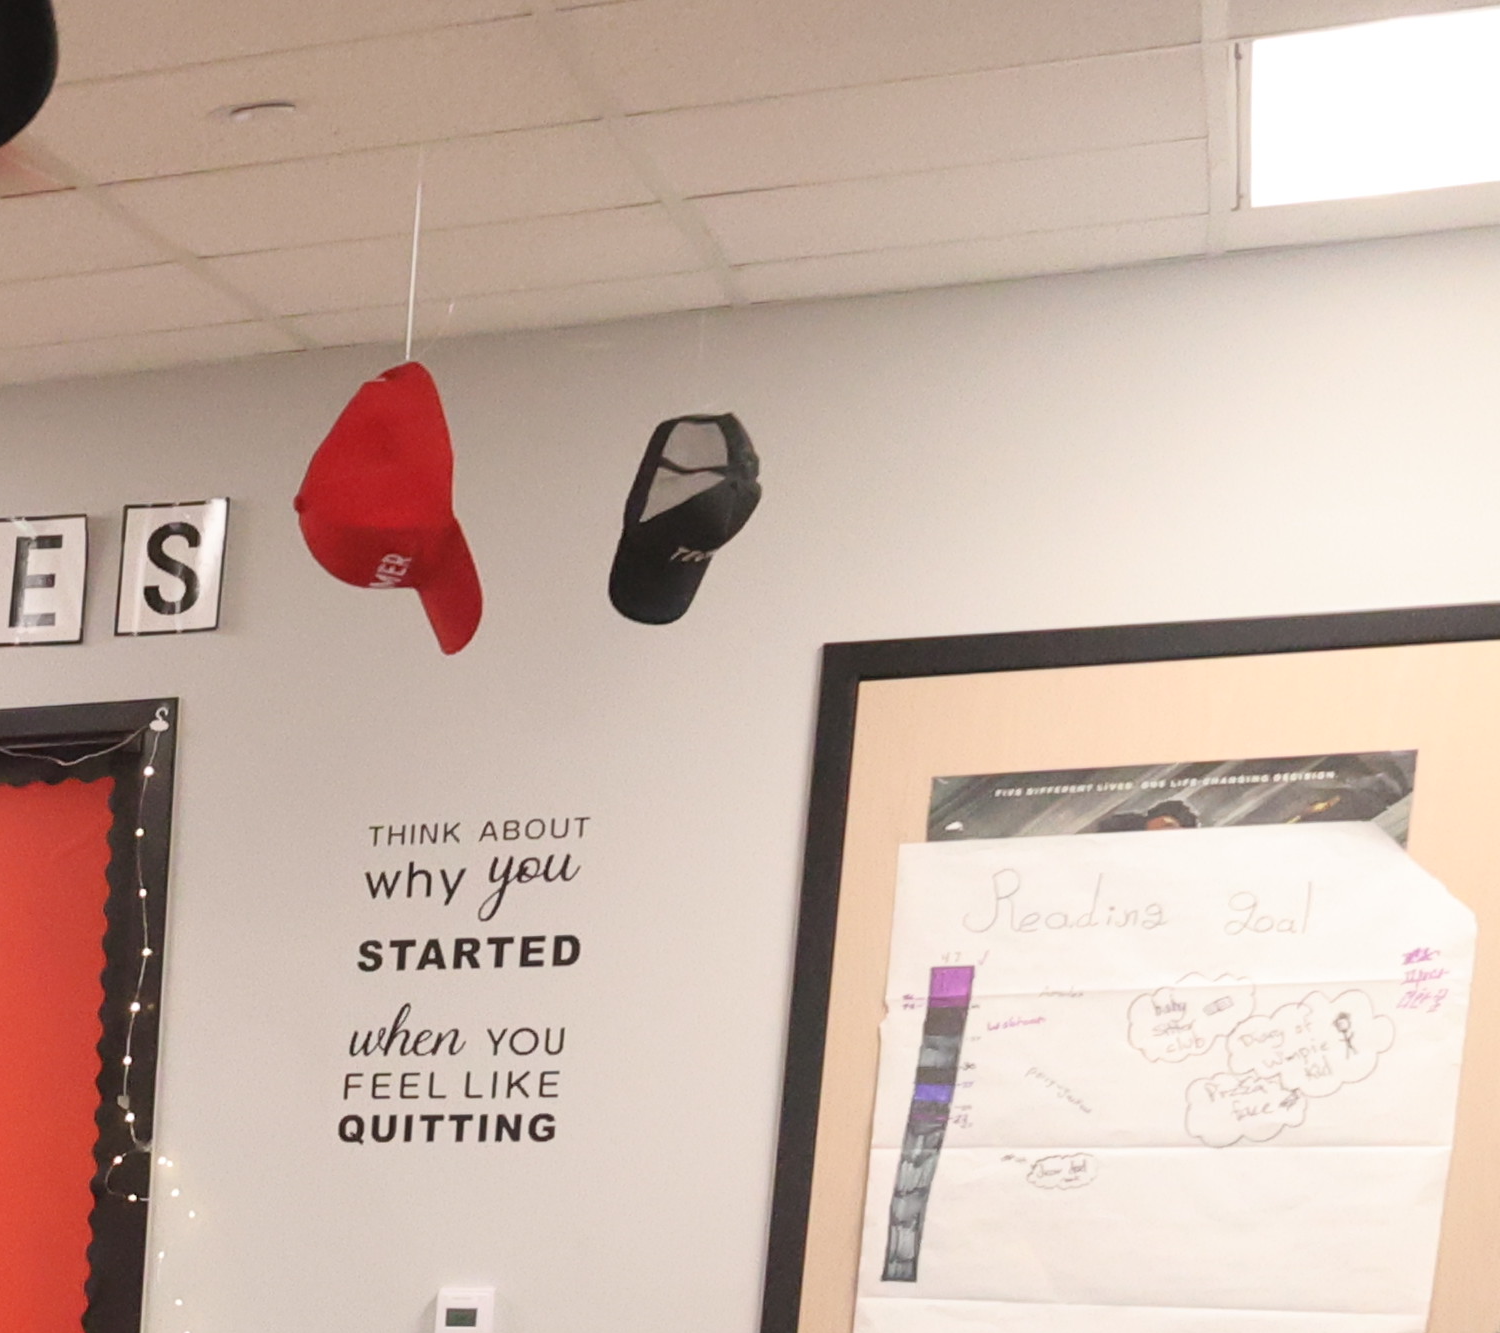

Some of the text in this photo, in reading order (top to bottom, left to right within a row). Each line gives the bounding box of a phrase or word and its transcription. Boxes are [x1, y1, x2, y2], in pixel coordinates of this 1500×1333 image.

[1025, 783, 1093, 796] DIFFERENT
[368, 816, 591, 847] THINK ABOUT
[365, 848, 581, 921] why you
[962, 869, 1169, 933] Reading
[357, 934, 581, 973] STARTED
[348, 1003, 566, 1057] when YOU
[343, 1070, 561, 1101] FEEL LIKE
[337, 1112, 558, 1144] QUITTING
